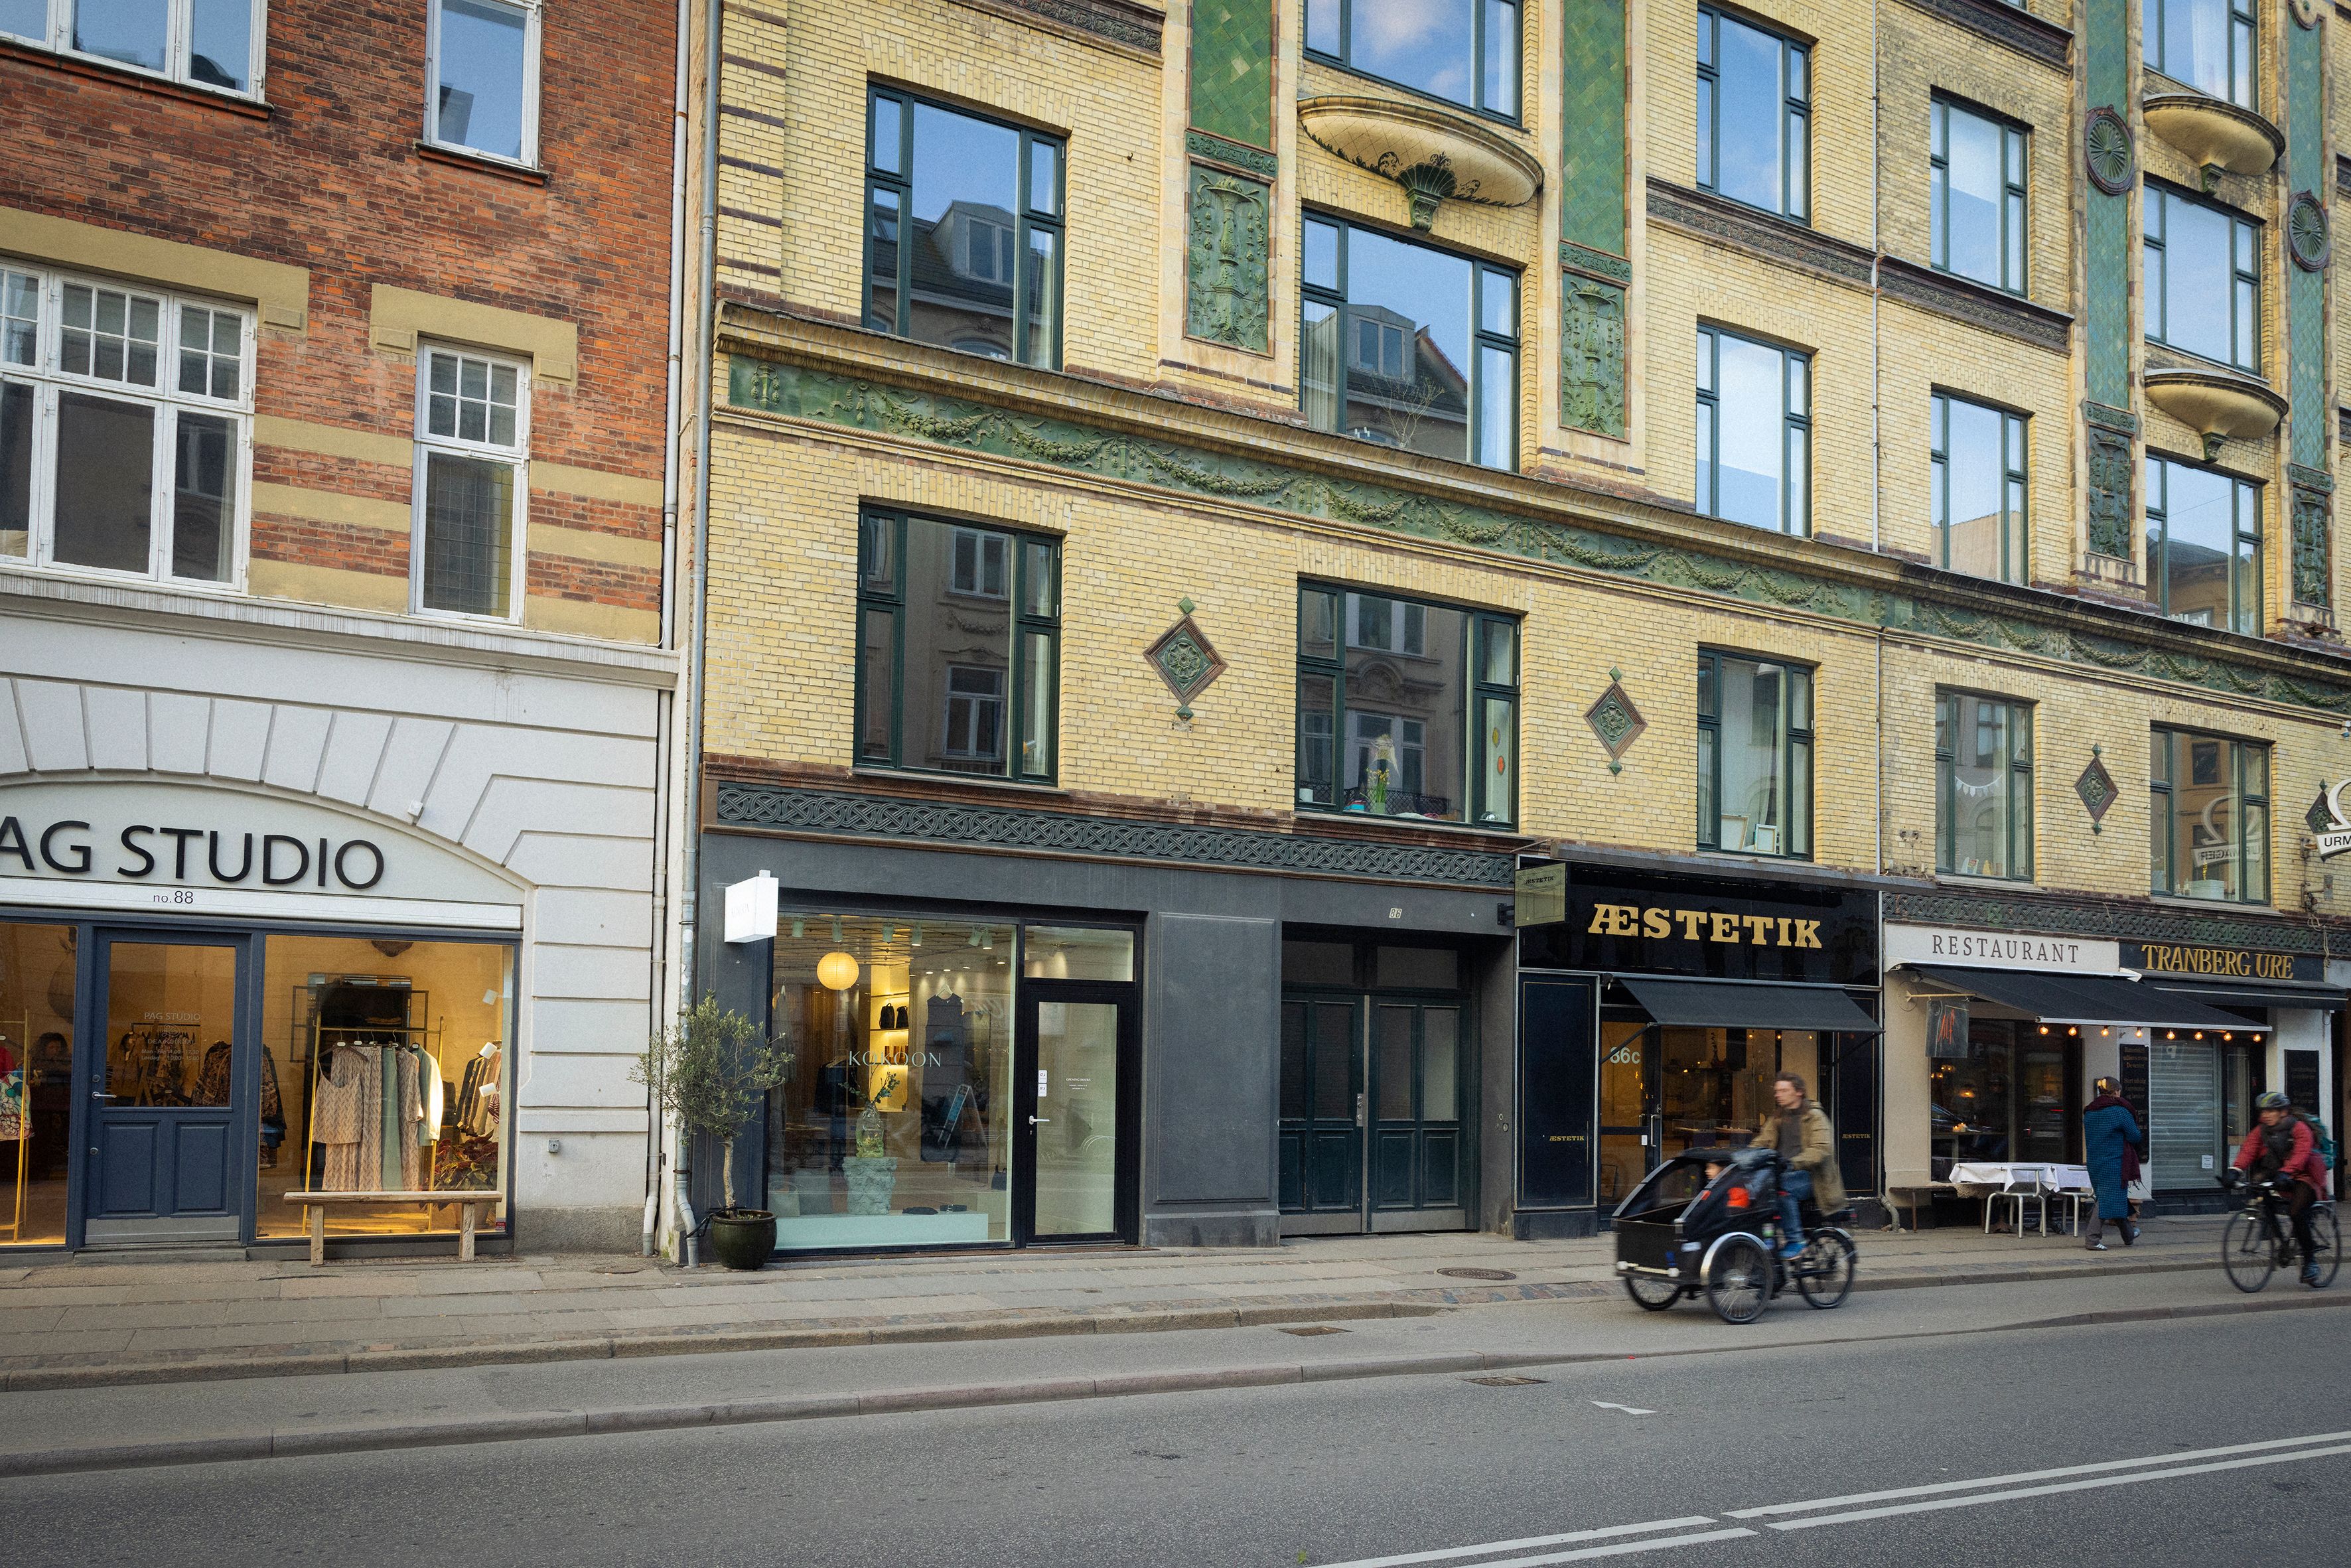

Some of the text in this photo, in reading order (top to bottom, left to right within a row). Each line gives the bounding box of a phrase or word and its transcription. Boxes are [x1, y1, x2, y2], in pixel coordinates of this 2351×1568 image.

[117, 825, 384, 889] STUDIO
[1526, 876, 1554, 885] ÆSTETIK
[1390, 908, 1401, 918] 86
[1588, 903, 1822, 949] ÆSTETIK
[1932, 934, 2079, 963] RESTAURANT
[2141, 944, 2294, 979] TRANBERG URE
[849, 1050, 941, 1068] KOKOON
[1610, 1046, 1640, 1064] 86c
